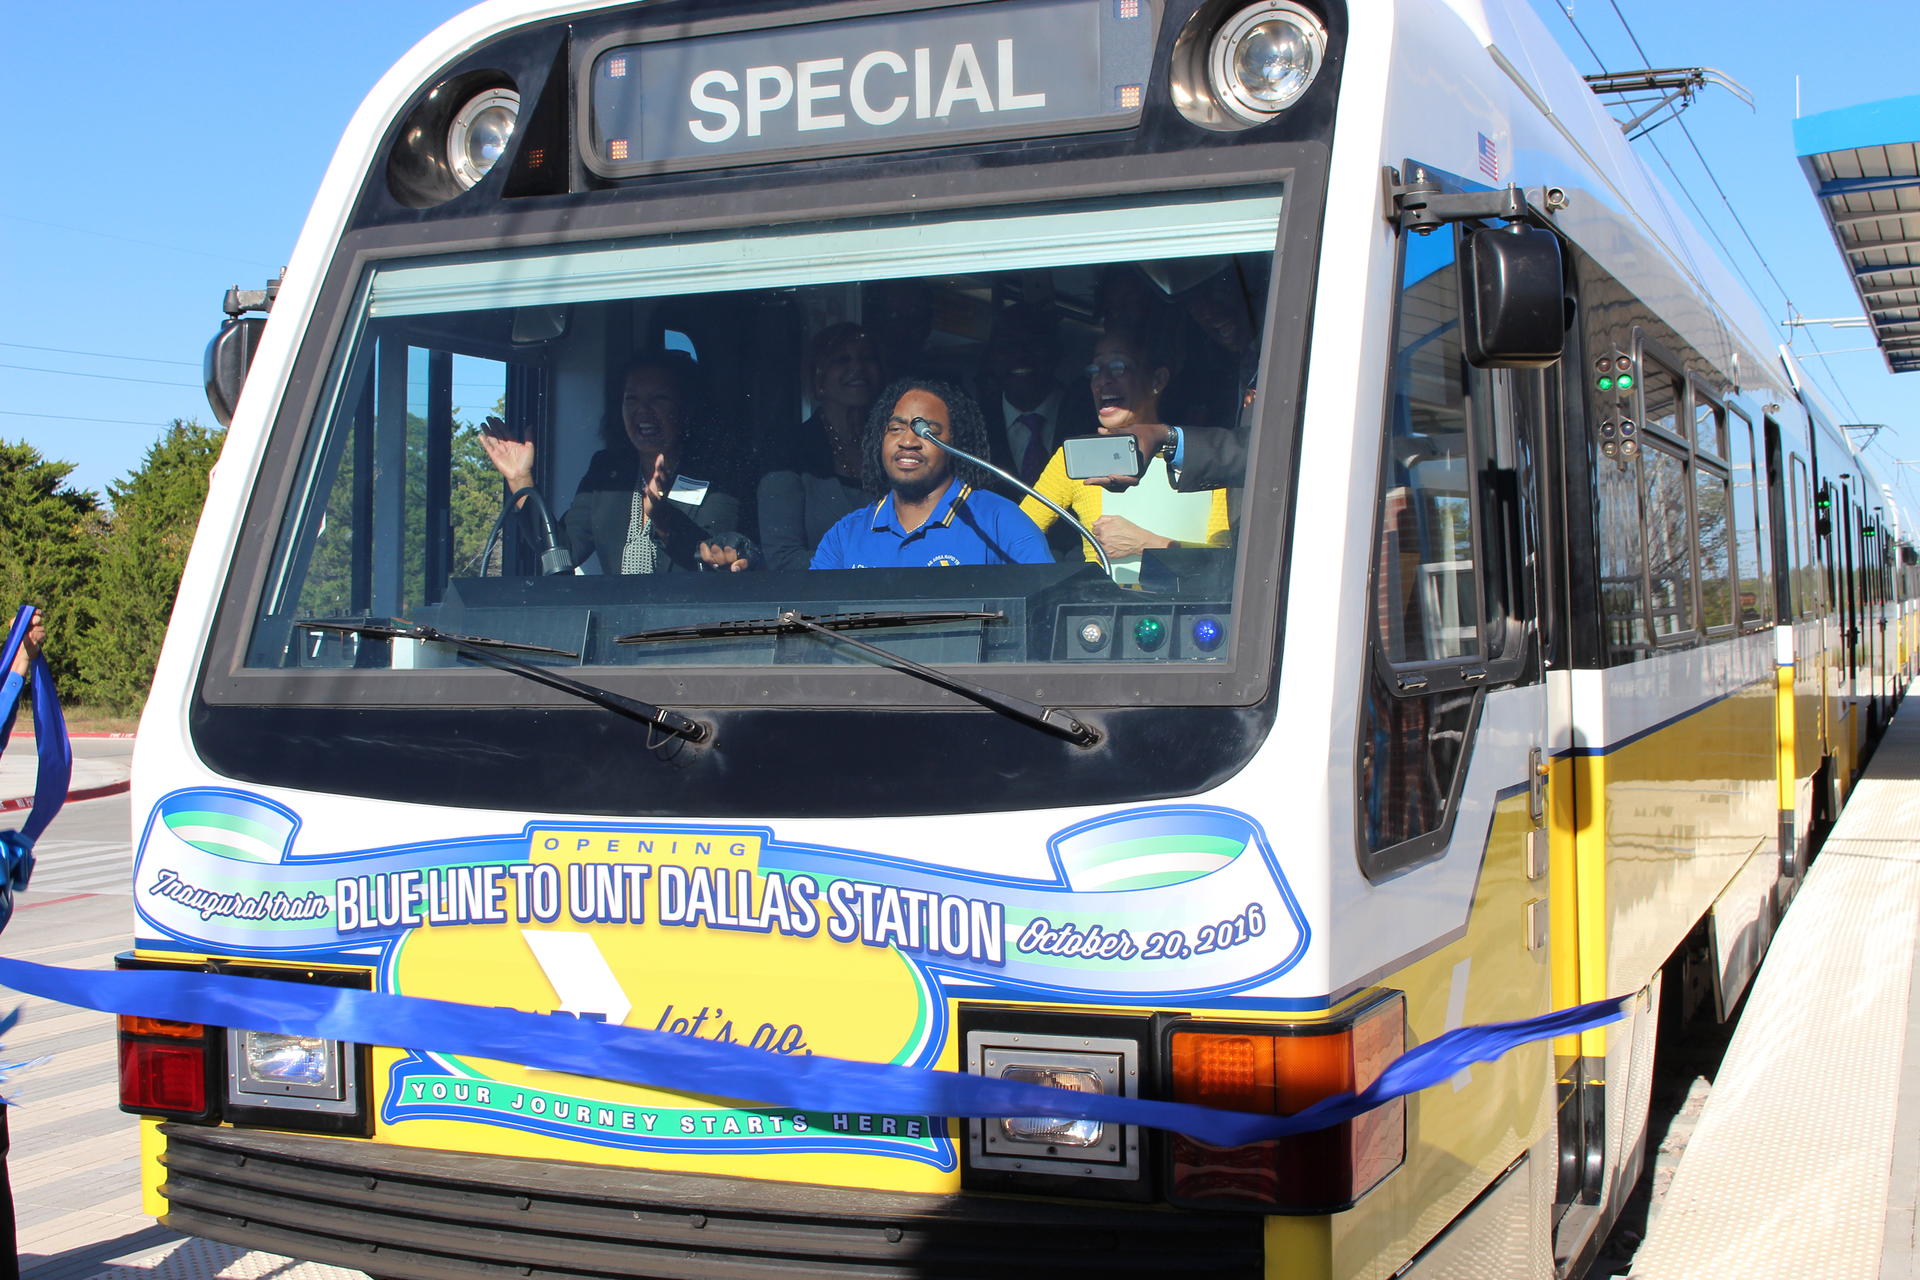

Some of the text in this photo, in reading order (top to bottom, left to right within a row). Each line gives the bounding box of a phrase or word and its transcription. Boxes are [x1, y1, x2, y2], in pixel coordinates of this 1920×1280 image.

[688, 39, 1046, 143] SPECIAL
[544, 837, 747, 856] OPENING
[149, 868, 330, 921] Inaugural train
[336, 862, 1006, 968] BLUE LINE TO UNT DALLAS STATION
[1016, 901, 1267, 961] October 20, 2016
[410, 1082, 922, 1139] YOUR JOURNEY STARTS HERE
